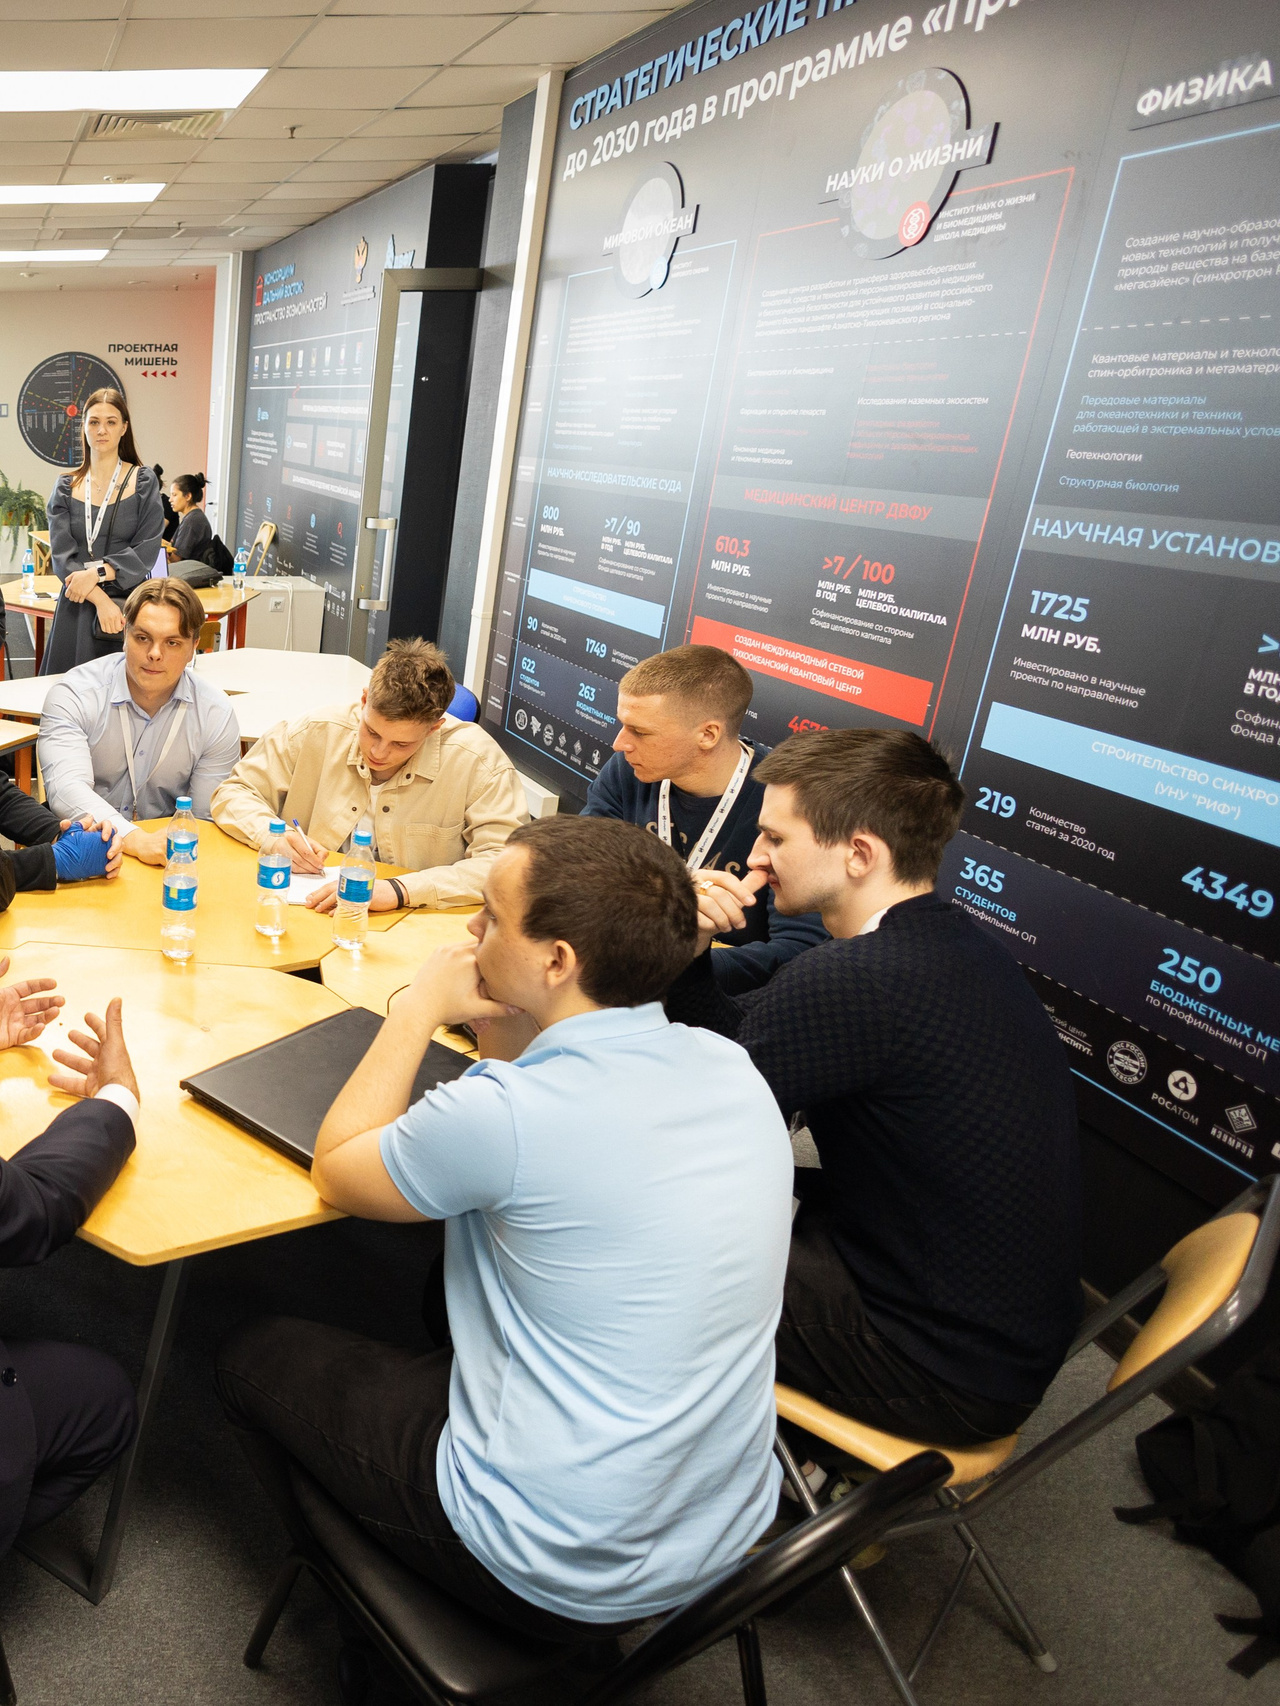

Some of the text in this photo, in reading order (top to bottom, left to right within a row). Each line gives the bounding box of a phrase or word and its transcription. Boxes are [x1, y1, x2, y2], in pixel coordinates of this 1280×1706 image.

[570, 0, 807, 130] СТРАТЕГИЧЕСКИЕ
[563, 0, 1019, 182] до 2030 года в программе «Пр
[1136, 60, 1272, 116] ФИЗИКА
[825, 135, 984, 193] НАУКИ О ЖИЗНИ
[938, 193, 1036, 219] ИНСТИТУТ НАУК О ЖИЗНИ
[602, 213, 694, 251] МИРОВОЙ ОКЕАН
[943, 211, 1002, 229] БИОМЕДИЦИНЫ
[933, 223, 1006, 242] ШКОЛА МЕДИЦИНЫ
[1125, 218, 1280, 249] Создание научно-образо
[1118, 247, 1280, 278] природы вещества на базе
[1121, 250, 1155, 263] новых
[1158, 239, 1226, 259] технологий
[1230, 240, 1238, 249] и
[853, 274, 888, 287] трансфера
[942, 271, 984, 287] медицины
[1192, 264, 1272, 286] (синхротрон
[906, 282, 993, 302] развития российского
[892, 299, 975, 316] позиций социально-
[919, 312, 950, 324] региона
[108, 344, 178, 352] ПРОЕКТНАЯ
[1091, 353, 1149, 364] Квантовые
[1151, 350, 1216, 363] материалы
[1220, 351, 1229, 359] и
[125, 357, 178, 365] МИШЕНЬ
[1088, 366, 1192, 378] спин-орбитроника
[858, 397, 989, 406] Исследования наземных экосистем
[1081, 395, 1207, 406] Передовые материалы
[1076, 410, 1243, 421] для океанотехники и техники,
[1073, 423, 1139, 434] работающей
[1141, 425, 1148, 433] в
[1150, 425, 1240, 436] экстремальных
[1066, 450, 1142, 462] Геотехнологии
[547, 467, 657, 489] НАУЧНО-ИССЛЕДОВАТЕЛЬСКИЕ
[659, 479, 682, 493] СУДА
[1059, 475, 1179, 493] Структурная биология
[542, 505, 559, 520] 800
[744, 489, 933, 521] МЕДИЦИНСКИЙ ЦЕНТР ДВФУ
[540, 524, 552, 534] МЛН
[604, 517, 617, 532] >7
[626, 520, 640, 536] 90
[715, 536, 751, 559] 610,3
[1032, 518, 1280, 564] НАУЧНАЯ УСТАНОВ
[711, 560, 751, 577] МЛН РУБ.
[822, 555, 846, 575] >7
[862, 560, 895, 584] 100
[818, 580, 851, 595] МЛН РУБ.
[822, 591, 836, 602] ГОД
[858, 588, 895, 604] МЛН РУБ.
[856, 599, 947, 626] ЦЕЛЕВОГО КАПИТАЛА
[1030, 590, 1089, 622] 1725
[527, 616, 538, 632] 90
[810, 618, 891, 644] Фонда целевого капитала
[812, 607, 914, 639] Софинансирование со стороны
[586, 638, 606, 658] 1749
[1021, 624, 1101, 654] МЛН РУБ.
[521, 657, 536, 674] 622
[734, 634, 864, 680] СОЗДАН МЕЖДУНАРОДНЫЙ СЕТЕВОЙ
[733, 648, 862, 696] ТИХООКЕАНСКИЙ КВАНТОВЫЙ ЦЕНТР
[1013, 657, 1146, 697] Инвестировано в научные
[578, 683, 596, 701] 263
[1010, 669, 1138, 709] проекты по направлению
[1244, 682, 1255, 694] В
[788, 716, 829, 733] 467
[1235, 710, 1280, 729] Софин
[1231, 724, 1274, 743] Фонда
[1091, 742, 1278, 806] СТРОИТЕЛЬСТВО СИНХРО
[975, 787, 1016, 818] 219
[1154, 781, 1241, 820] (УНУ "РИФ")
[1029, 806, 1086, 835] Количество
[1026, 818, 1115, 861] статей за 2020 год
[959, 857, 1005, 893] 365
[955, 886, 1017, 922] СТУДЕНТОВ
[1181, 866, 1274, 918] 4349
[963, 904, 1020, 937] профильным
[1021, 932, 1036, 945] ОП
[1157, 948, 1221, 994] 250
[1149, 980, 1253, 1038] БЮДЖЕТНЫХ
[1145, 994, 1268, 1064] по профильным ОП
[1112, 1043, 1145, 1067] МЧС РОССИИ
[1110, 1064, 1138, 1082] EMERCOM
[1151, 1093, 1199, 1126] РОСАТОМ
[1211, 1126, 1254, 1159] ИЗУМРУД
